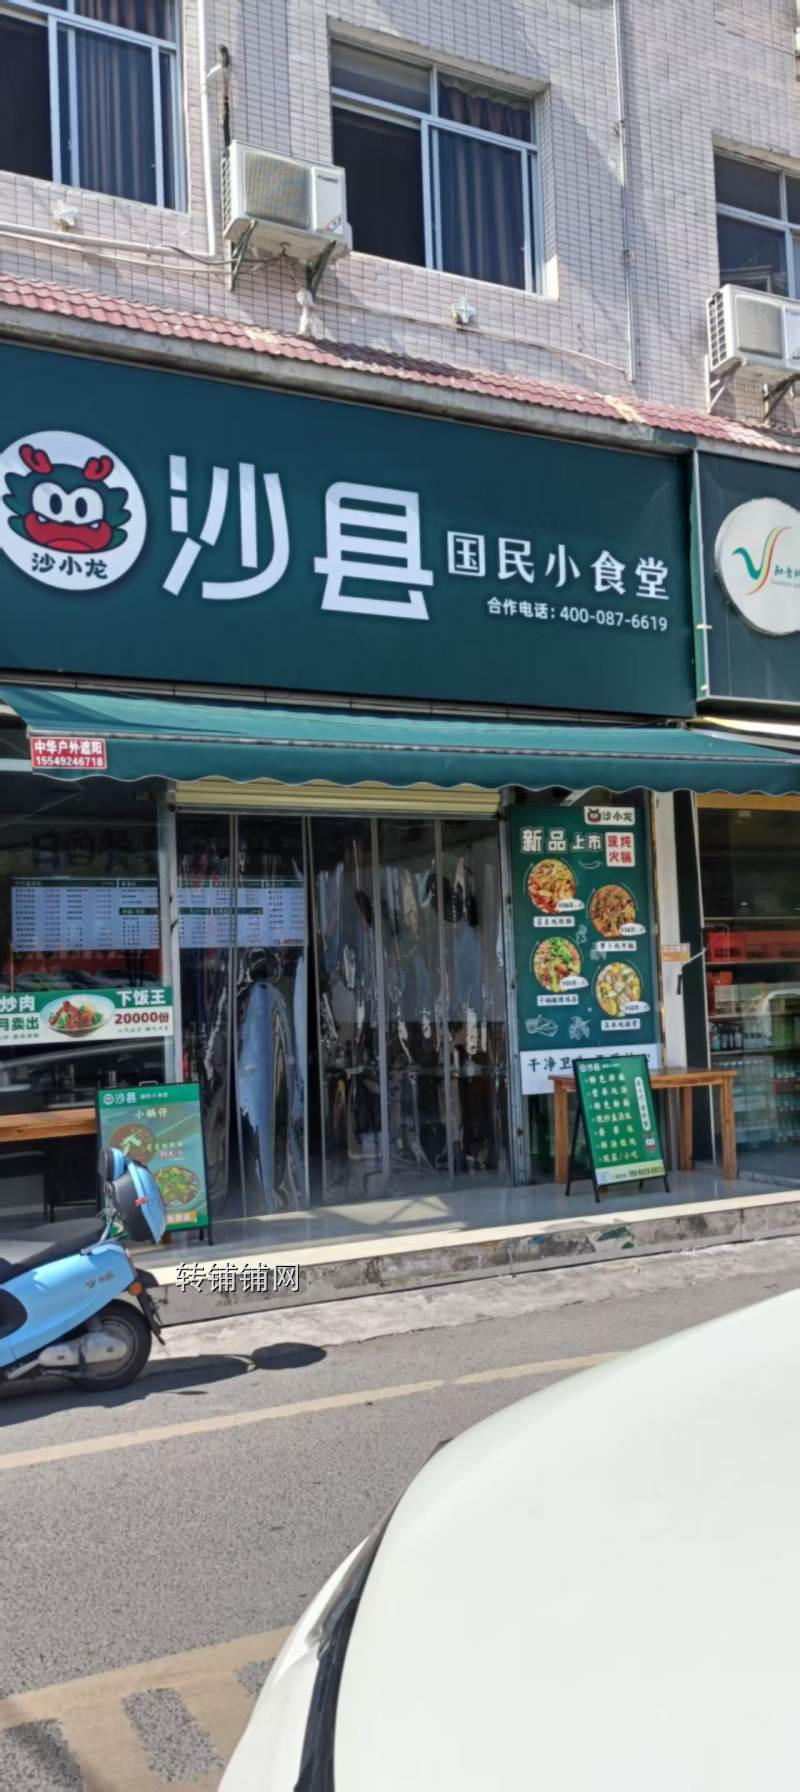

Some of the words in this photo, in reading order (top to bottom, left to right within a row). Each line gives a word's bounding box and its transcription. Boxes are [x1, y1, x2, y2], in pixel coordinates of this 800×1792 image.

[162, 454, 434, 621] 沙县
[446, 530, 670, 601] 国民小食堂
[31, 551, 109, 580] 沙小龙
[34, 740, 103, 755] 中华户外遮阳
[35, 756, 104, 767] 15549246718
[609, 851, 633, 864] 火锅
[0, 995, 35, 1013] 炒肉
[116, 988, 166, 1007] 下饭王
[0, 1016, 39, 1032] 月卖出
[114, 1011, 170, 1025] 20000份
[528, 1055, 583, 1073] 干净卫
